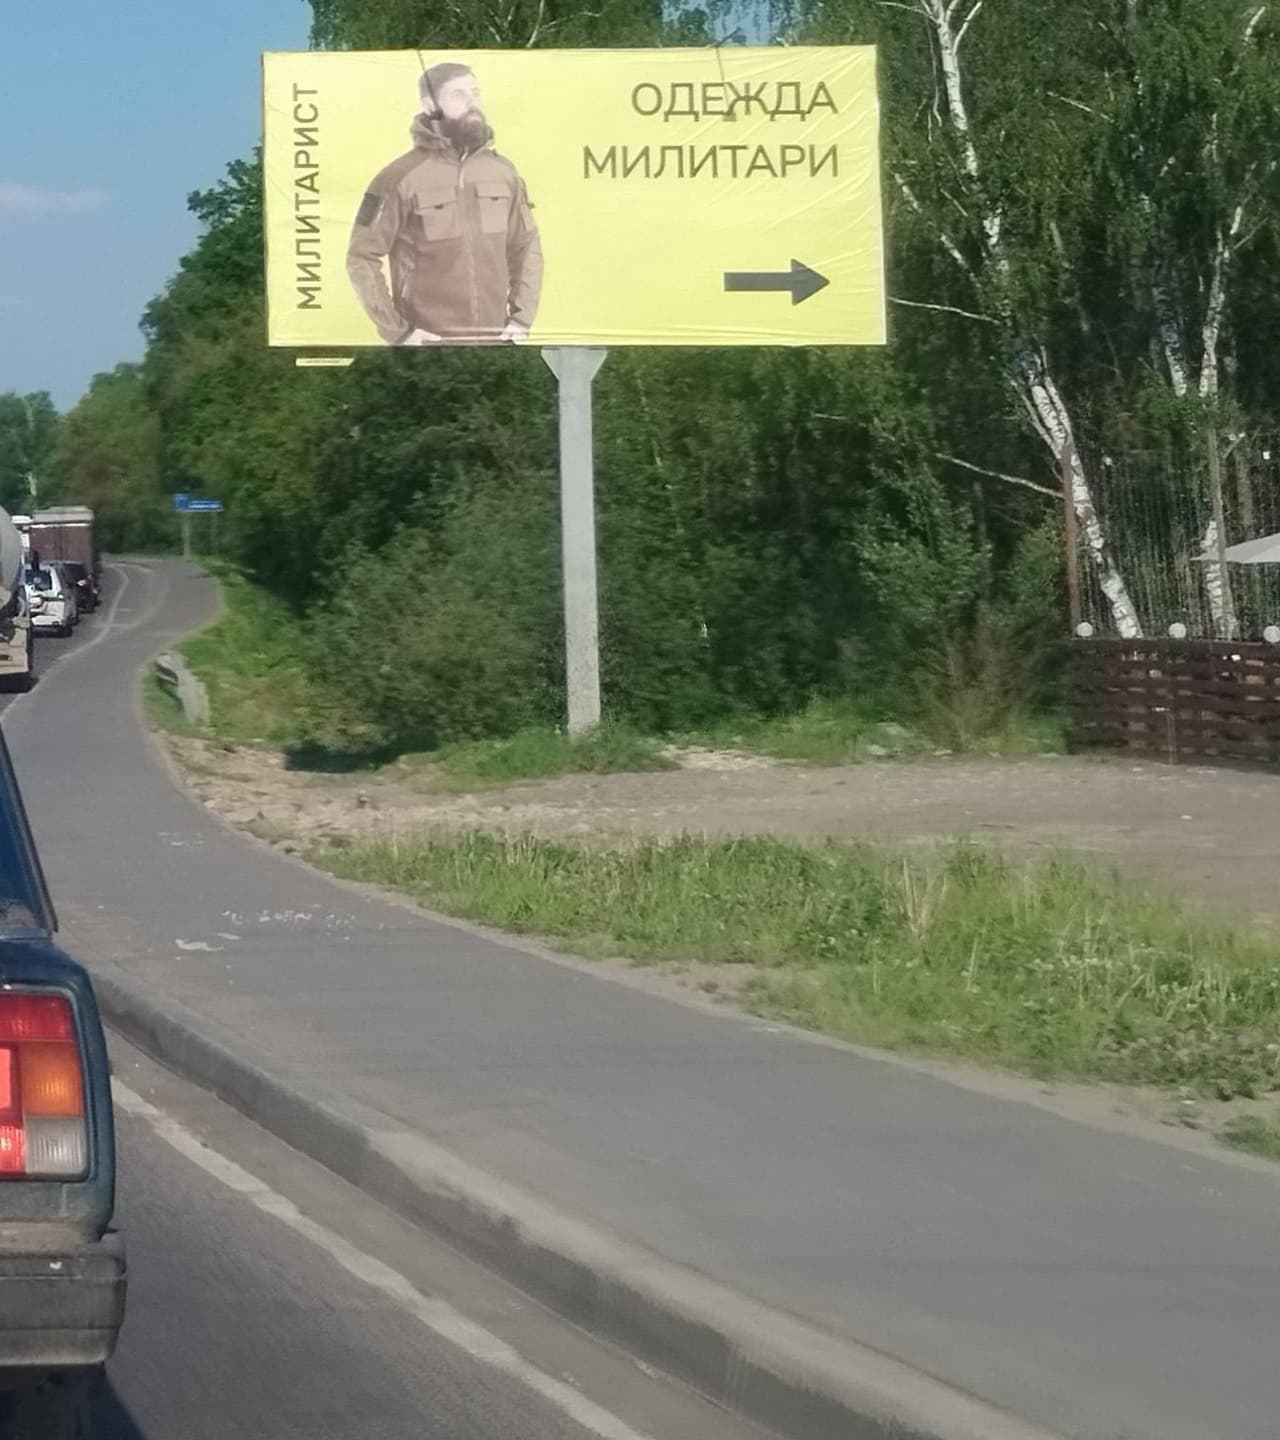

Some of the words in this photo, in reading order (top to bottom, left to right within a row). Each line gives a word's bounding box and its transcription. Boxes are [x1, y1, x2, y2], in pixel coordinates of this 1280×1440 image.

[631, 80, 839, 122] ОДЕЖДА
[582, 144, 840, 180] МИЛИТАРИ
[295, 83, 321, 310] МИЛИТАРИСТ
